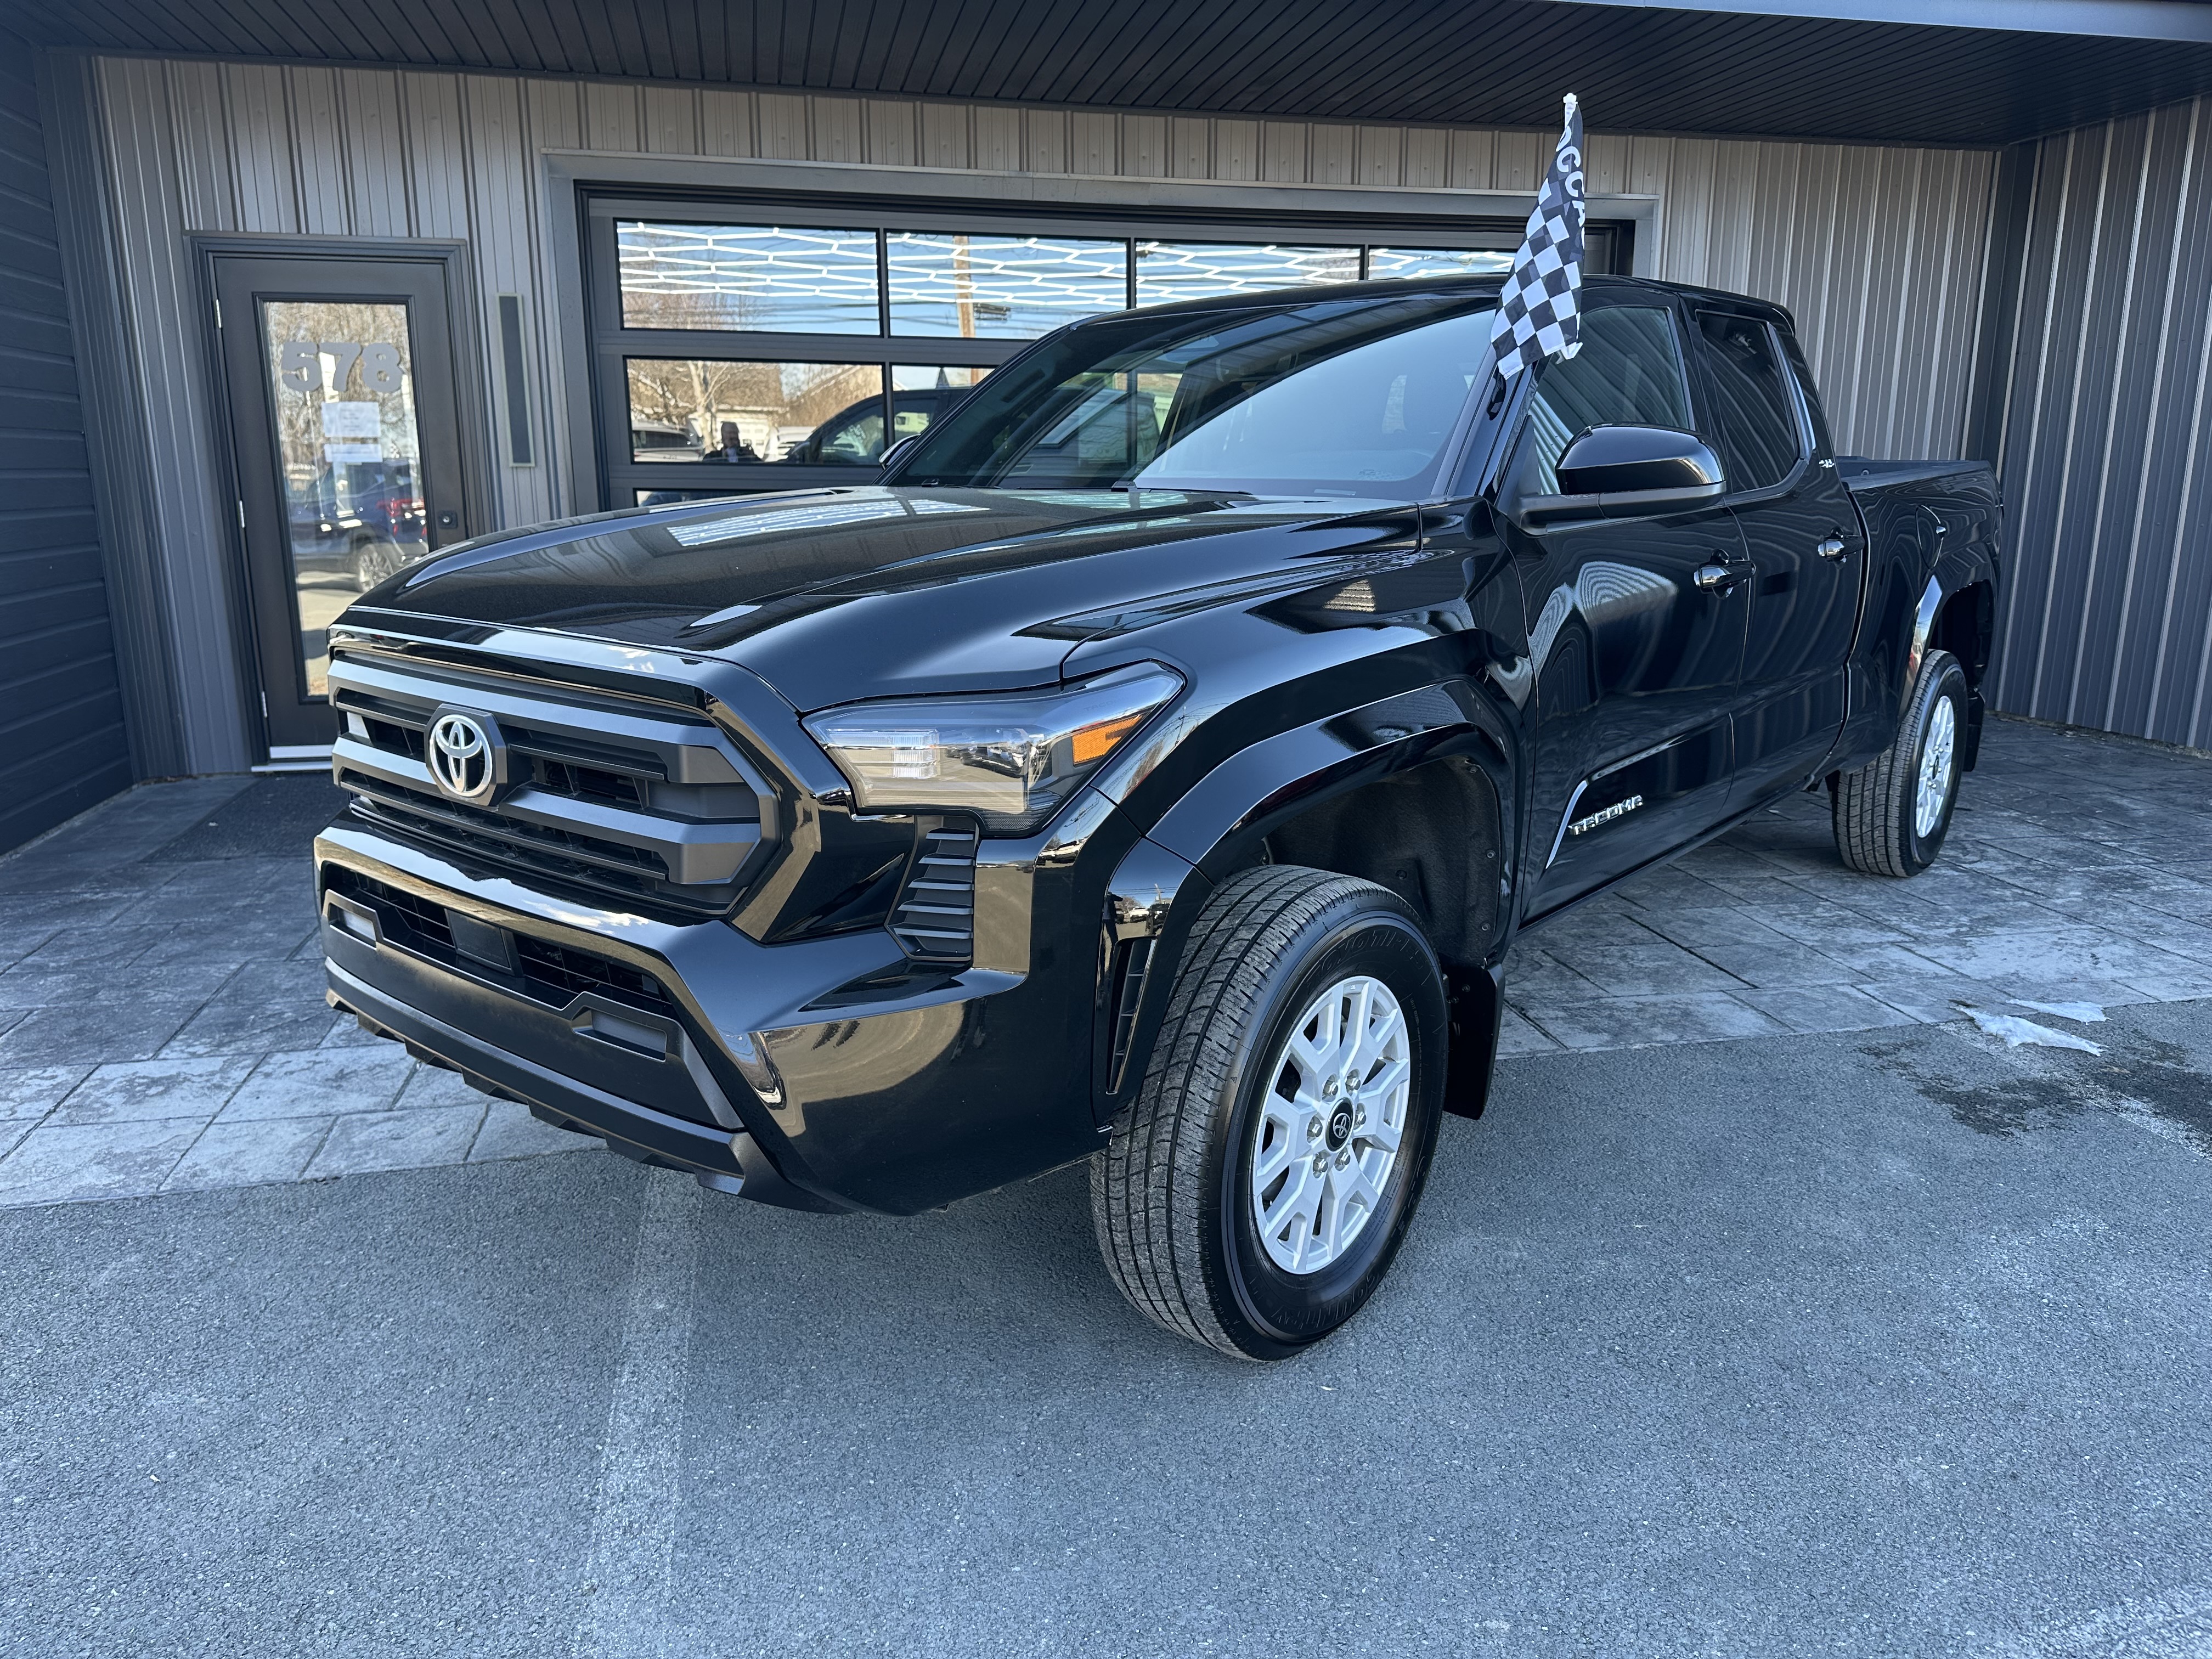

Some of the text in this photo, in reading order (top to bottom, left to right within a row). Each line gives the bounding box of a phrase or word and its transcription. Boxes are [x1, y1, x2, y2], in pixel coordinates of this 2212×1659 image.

[1556, 126, 1585, 250] OCCA
[281, 341, 403, 393] 578
[1568, 795, 1643, 835] TACOMA
